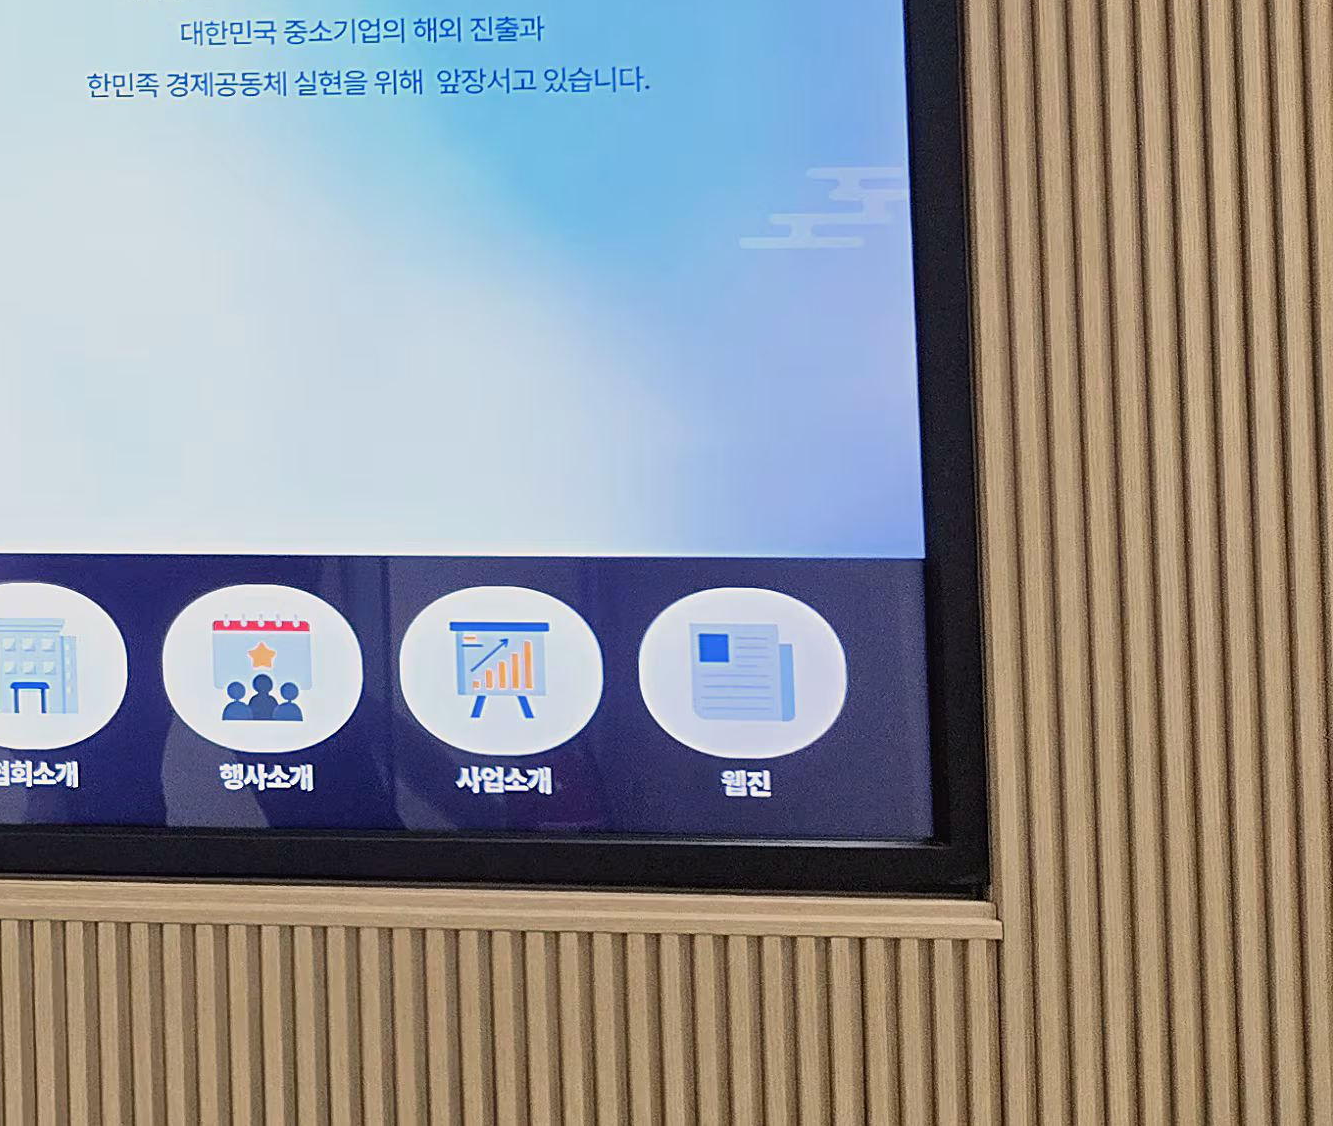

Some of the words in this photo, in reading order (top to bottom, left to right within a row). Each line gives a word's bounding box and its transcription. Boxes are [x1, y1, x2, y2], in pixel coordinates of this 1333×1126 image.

[180, 20, 277, 46] 대한민국
[283, 18, 405, 44] 중소기업의
[413, 17, 462, 43] 해외
[470, 15, 545, 42] 진출과
[87, 73, 160, 98] 한민족
[166, 71, 287, 97] 경제공동체
[294, 70, 368, 96] 실현을
[374, 68, 423, 95] 위해
[437, 67, 537, 94] 앞장서고
[543, 66, 651, 93] 있습니다.
[219, 763, 314, 791] 행사소개
[455, 765, 553, 795] 사업소개
[721, 769, 772, 798] 웹진
